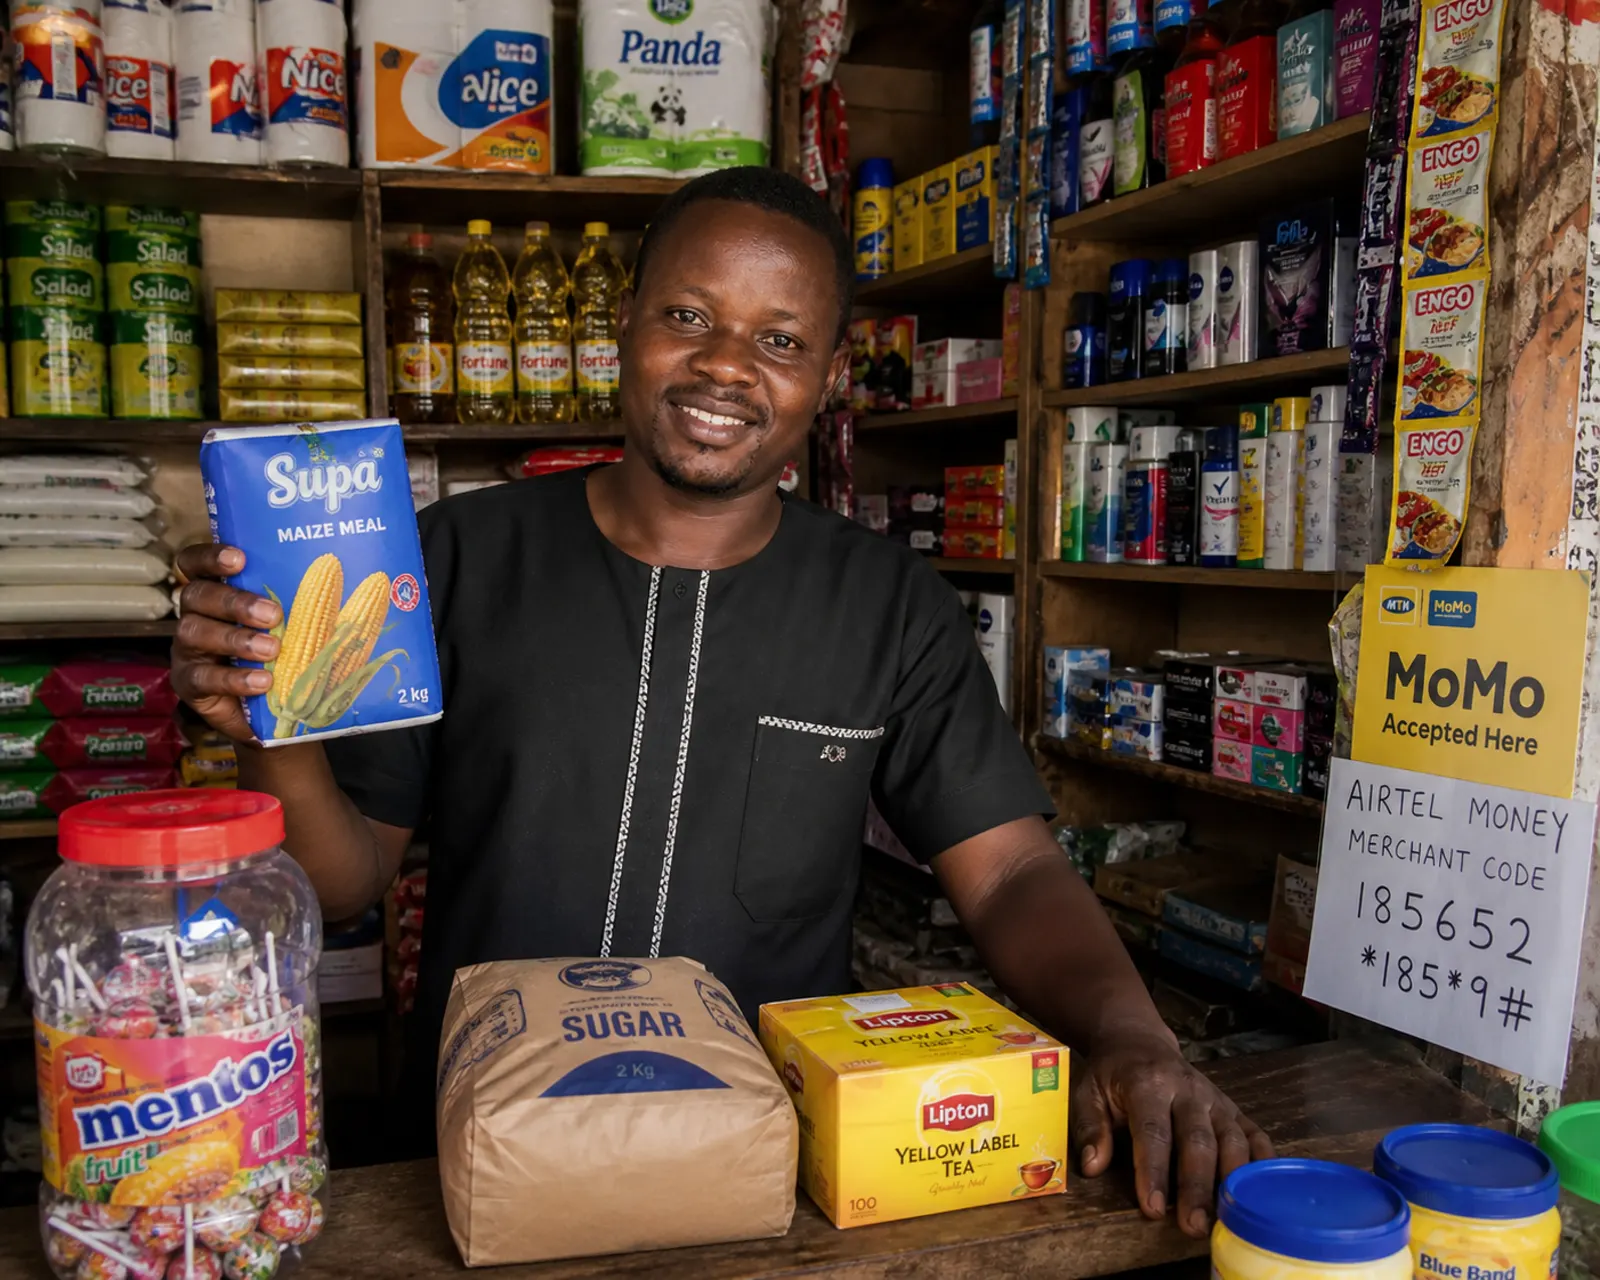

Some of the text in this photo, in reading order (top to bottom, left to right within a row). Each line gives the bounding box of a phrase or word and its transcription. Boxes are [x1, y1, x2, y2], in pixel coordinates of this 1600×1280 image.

[619, 29, 723, 65] Panda
[1422, 137, 1480, 172] ENGO
[136, 239, 189, 264] Salad
[33, 275, 92, 298] Salad
[1415, 284, 1474, 316] ENGO
[580, 354, 621, 369] Fortun
[1408, 429, 1465, 457] ENGO
[264, 453, 383, 513] Supa
[277, 516, 387, 543] MAIZE MEAL
[1386, 599, 1411, 611] MTN
[1433, 600, 1472, 614] MoMo
[397, 687, 429, 704] 2 kg
[1385, 651, 1545, 719] MoMo
[1382, 712, 1538, 756] Accepted Here
[1347, 779, 1569, 853] AIRTEL MONEY
[1348, 829, 1546, 891] MERCHANT CODE
[1357, 881, 1532, 965] 185652
[561, 1010, 686, 1042] SUGAR
[863, 1010, 948, 1028] Lipton
[616, 1063, 655, 1079] 2 Kg
[75, 1030, 296, 1147] mentos
[929, 1102, 989, 1125] Lipton
[896, 1133, 1020, 1165] YELLOW LABEL
[84, 1147, 146, 1181] fruit
[942, 1159, 975, 1178] TEA
[849, 1196, 877, 1211] 100
[1420, 1252, 1516, 1280] Blue Band
